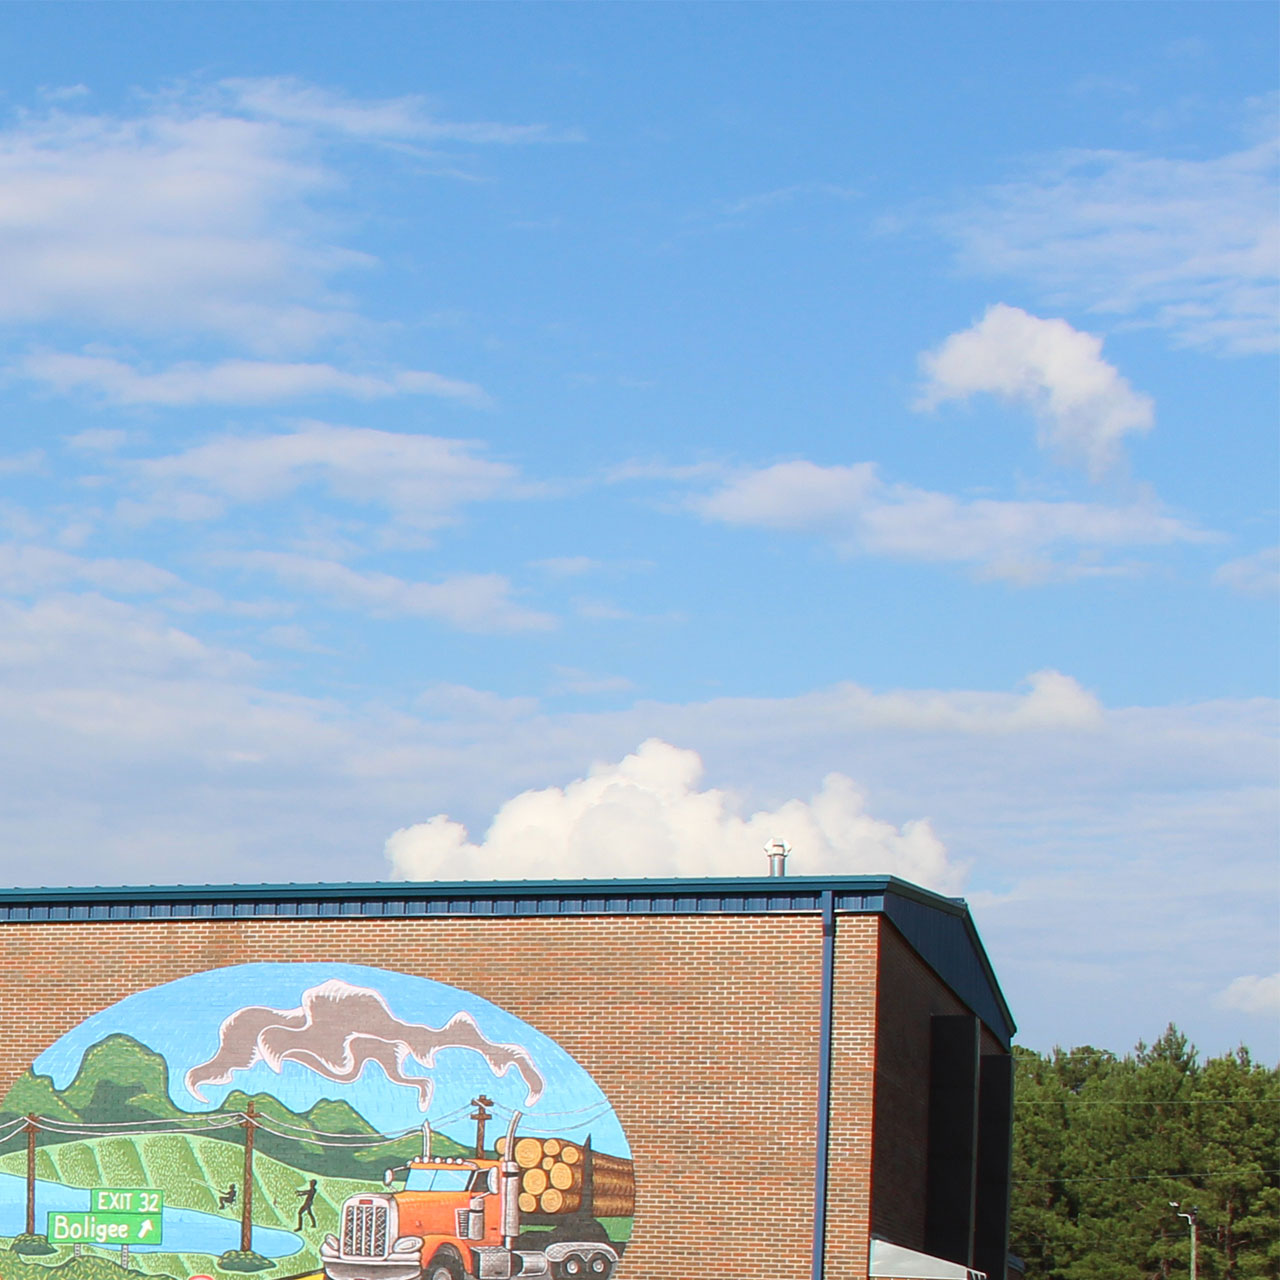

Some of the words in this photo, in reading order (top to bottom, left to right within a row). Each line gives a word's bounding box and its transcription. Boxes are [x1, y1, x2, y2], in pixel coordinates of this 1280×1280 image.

[96, 1191, 133, 1210] EXIT
[138, 1193, 160, 1212] 32
[54, 1215, 129, 1243] Boligee
